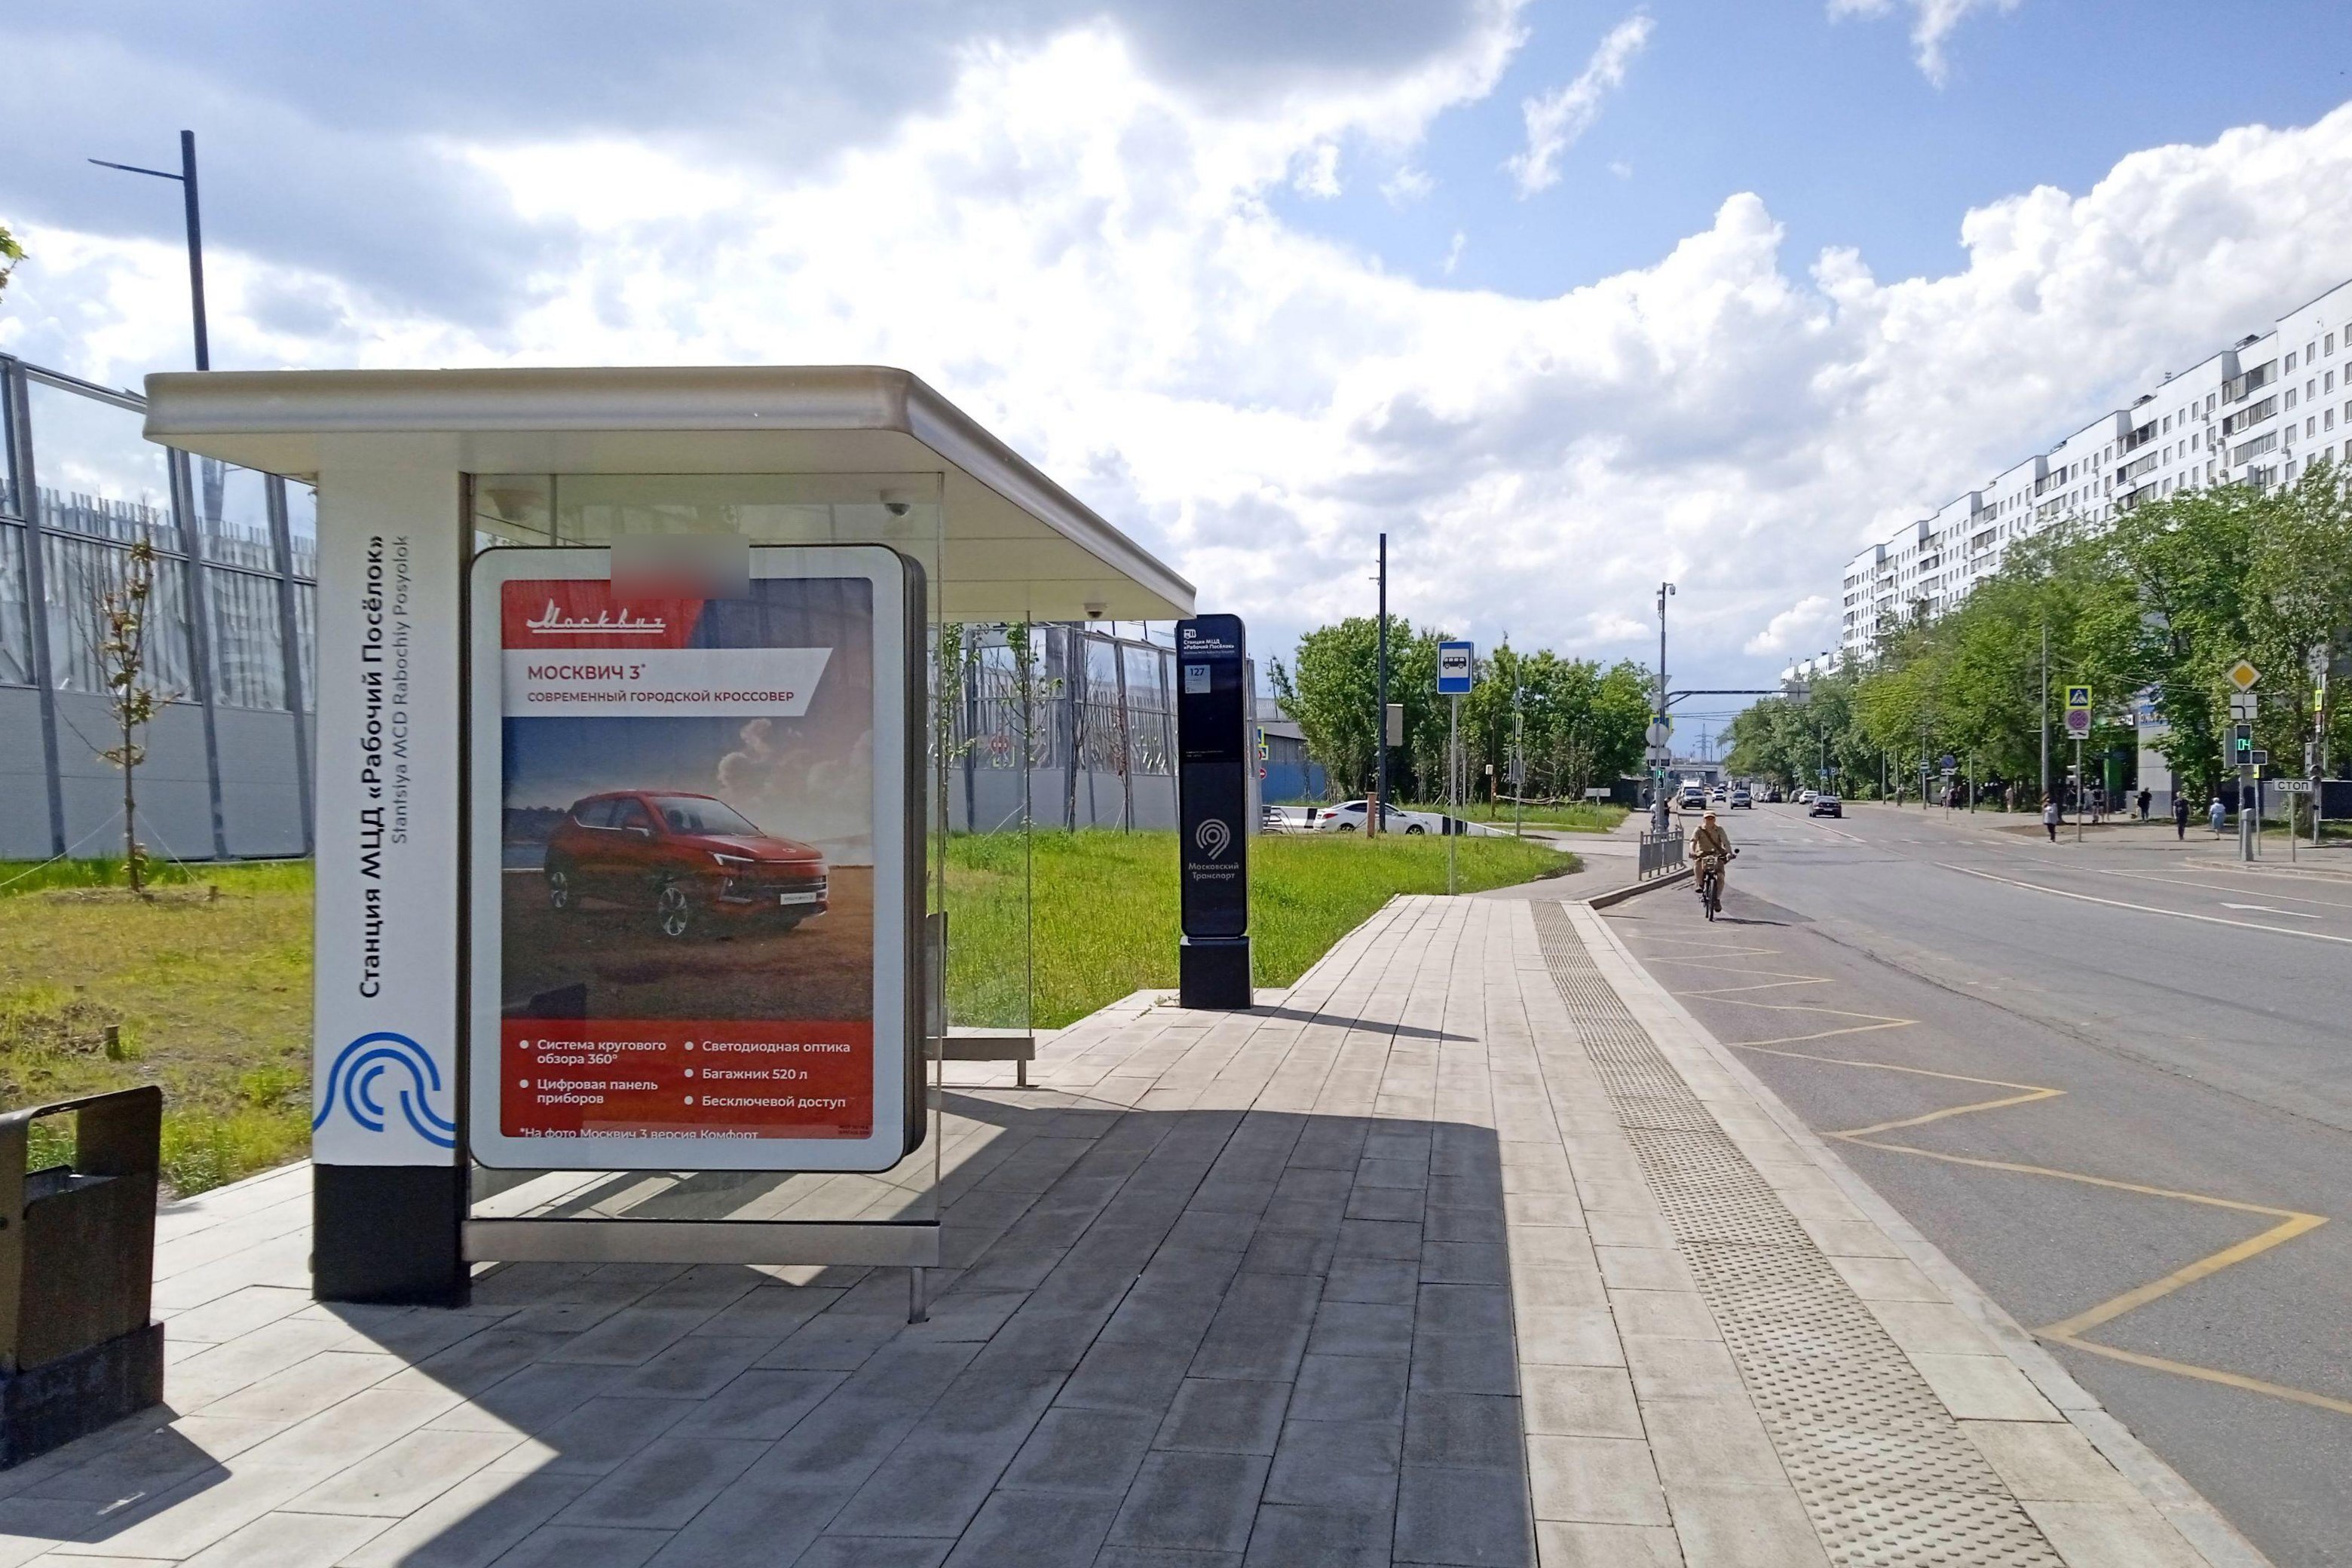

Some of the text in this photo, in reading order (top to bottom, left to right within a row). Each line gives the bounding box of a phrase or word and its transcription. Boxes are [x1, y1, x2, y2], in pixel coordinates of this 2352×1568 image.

[528, 666, 624, 680] МОСКВИЧ
[1190, 668, 1205, 676] 127
[391, 536, 411, 844] Stantsiya MCD Rabochiy Posyolok
[528, 689, 794, 704] СОВРЕМЕННЫЙ ГОРОДСКОЙ КРОССОВЕР
[359, 536, 383, 998] Станция МЦД «Рабочий Посёлок»
[2277, 782, 2309, 790] СТОП
[1189, 862, 1239, 870] Московский
[1193, 871, 1235, 880] Транспорт
[537, 1040, 666, 1055] Система кругового
[703, 1040, 850, 1055] Светодиодная оптика
[537, 1052, 617, 1065] обзора 360°
[703, 1069, 807, 1080] Багажник 520 л
[537, 1079, 658, 1092] Цифровая панель
[537, 1092, 604, 1106] приборов
[703, 1095, 846, 1110] Бесключевой доступ
[580, 1129, 635, 1138] Москвич
[640, 1129, 647, 1138] 3
